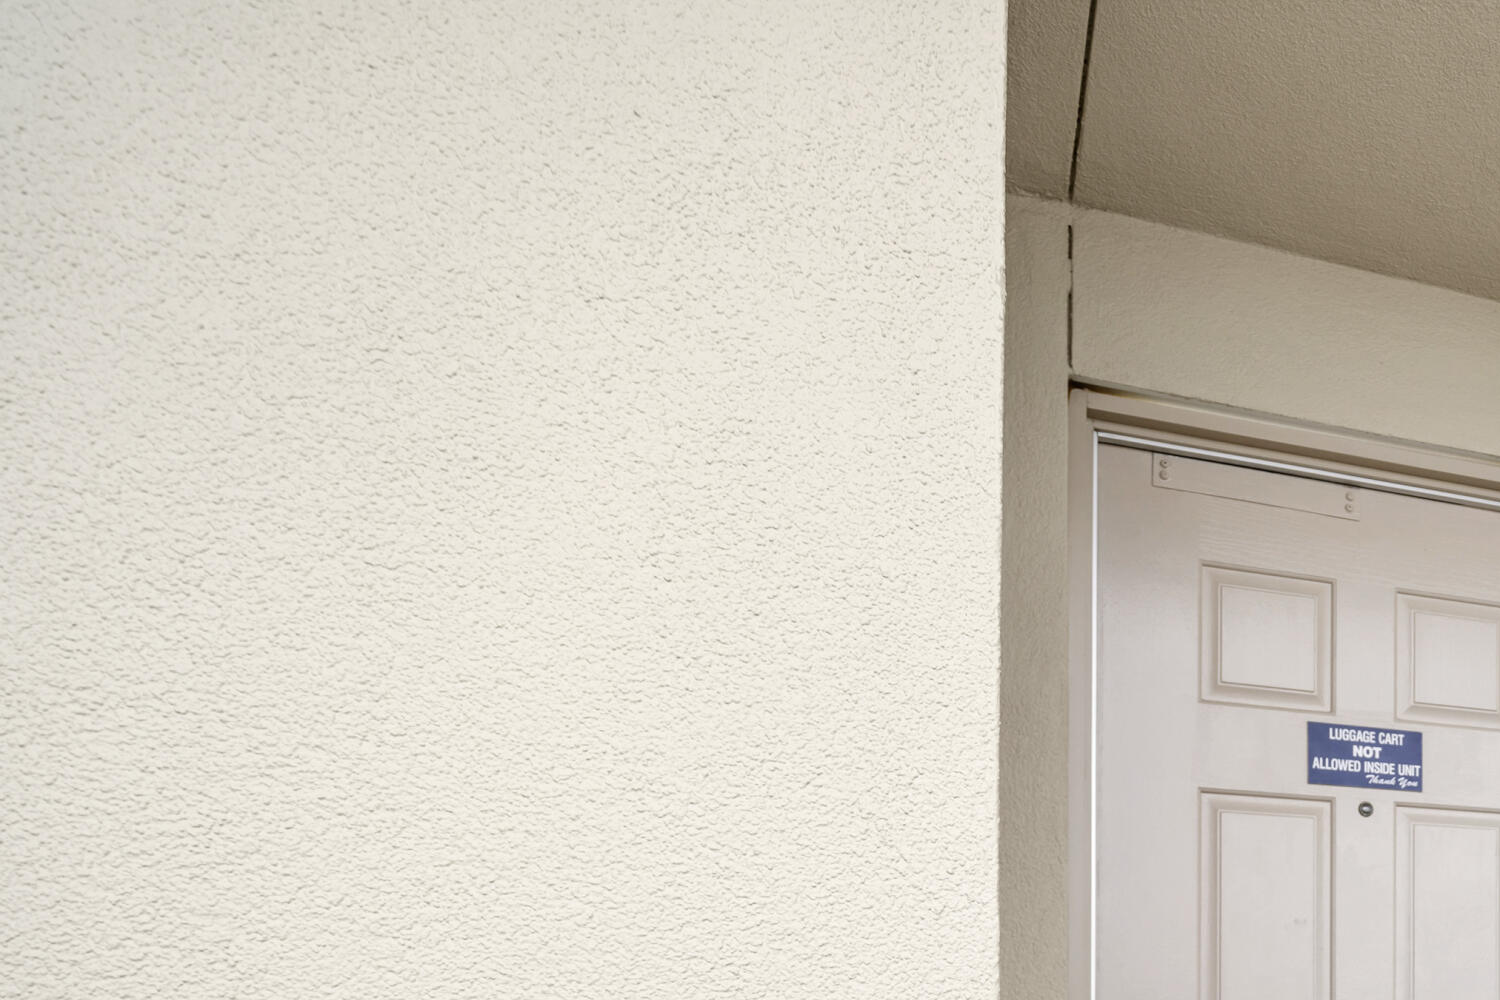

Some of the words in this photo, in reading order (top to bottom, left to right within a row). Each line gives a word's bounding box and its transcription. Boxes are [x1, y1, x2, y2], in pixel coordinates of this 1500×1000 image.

[1329, 727, 1376, 743] LUGGAGE
[1378, 732, 1405, 746] CART
[1352, 745, 1382, 759] NOT
[1312, 757, 1361, 772] ALLOWED
[1364, 762, 1395, 775] INSIDE
[1398, 764, 1421, 777] UNIT
[1365, 774, 1396, 785] Thank
[1398, 776, 1418, 789] You
